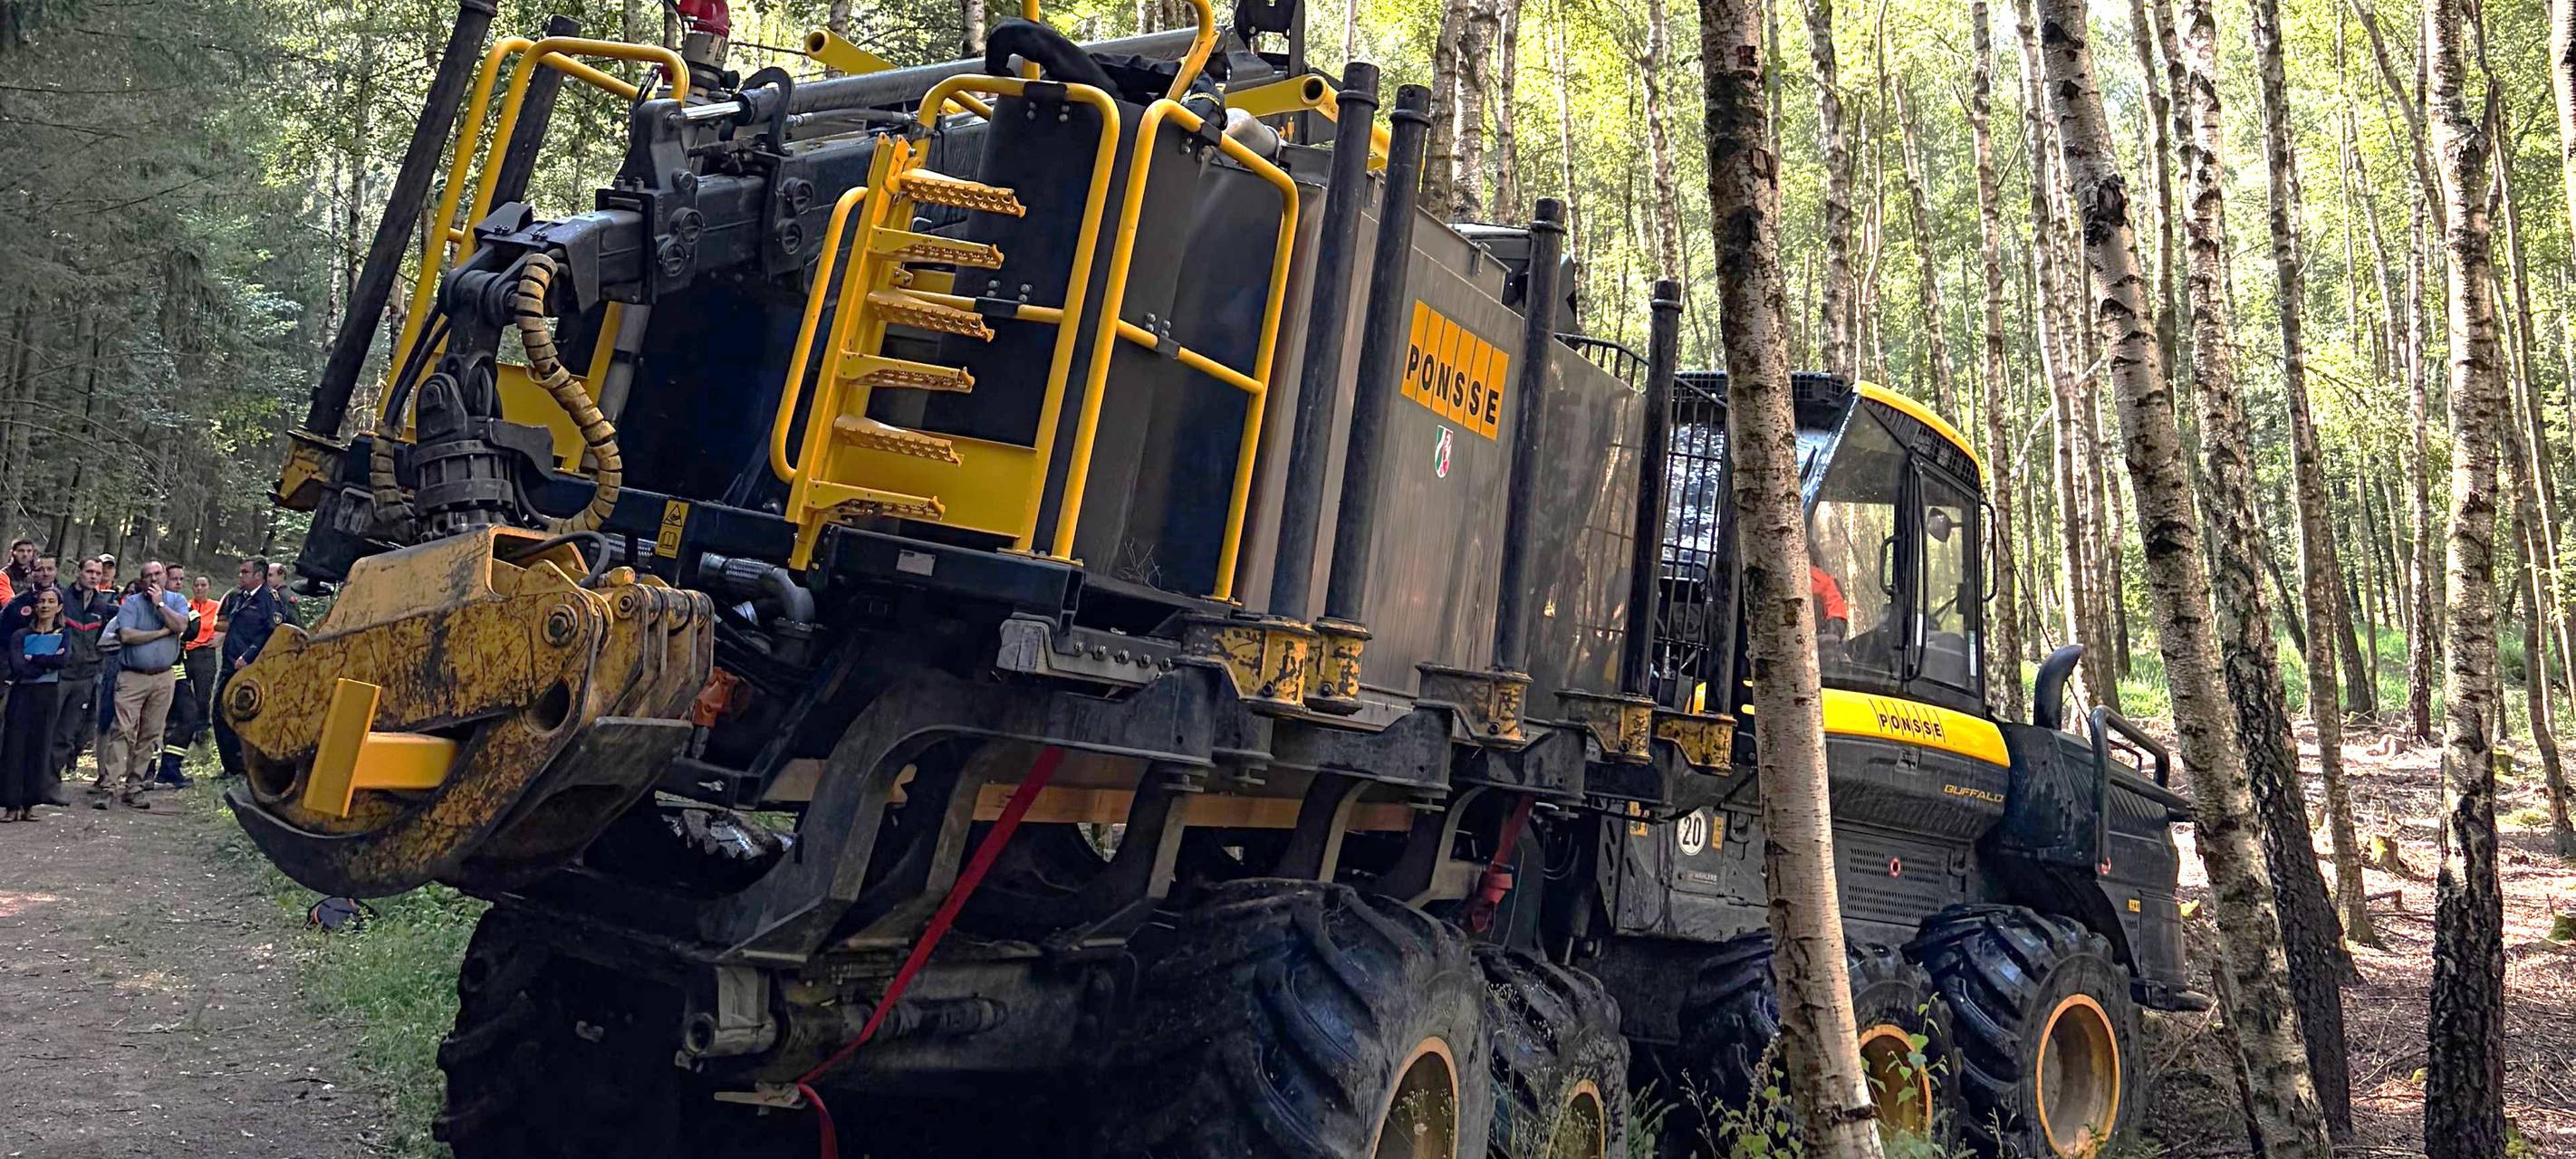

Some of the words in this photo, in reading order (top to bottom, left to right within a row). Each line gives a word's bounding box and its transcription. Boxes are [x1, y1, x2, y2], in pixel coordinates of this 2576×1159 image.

[1406, 344, 1499, 425] PONSSE
[1879, 714, 1942, 736] PONSSE
[1944, 784, 2004, 802] BUFFALO
[1682, 817, 1702, 847] 20
